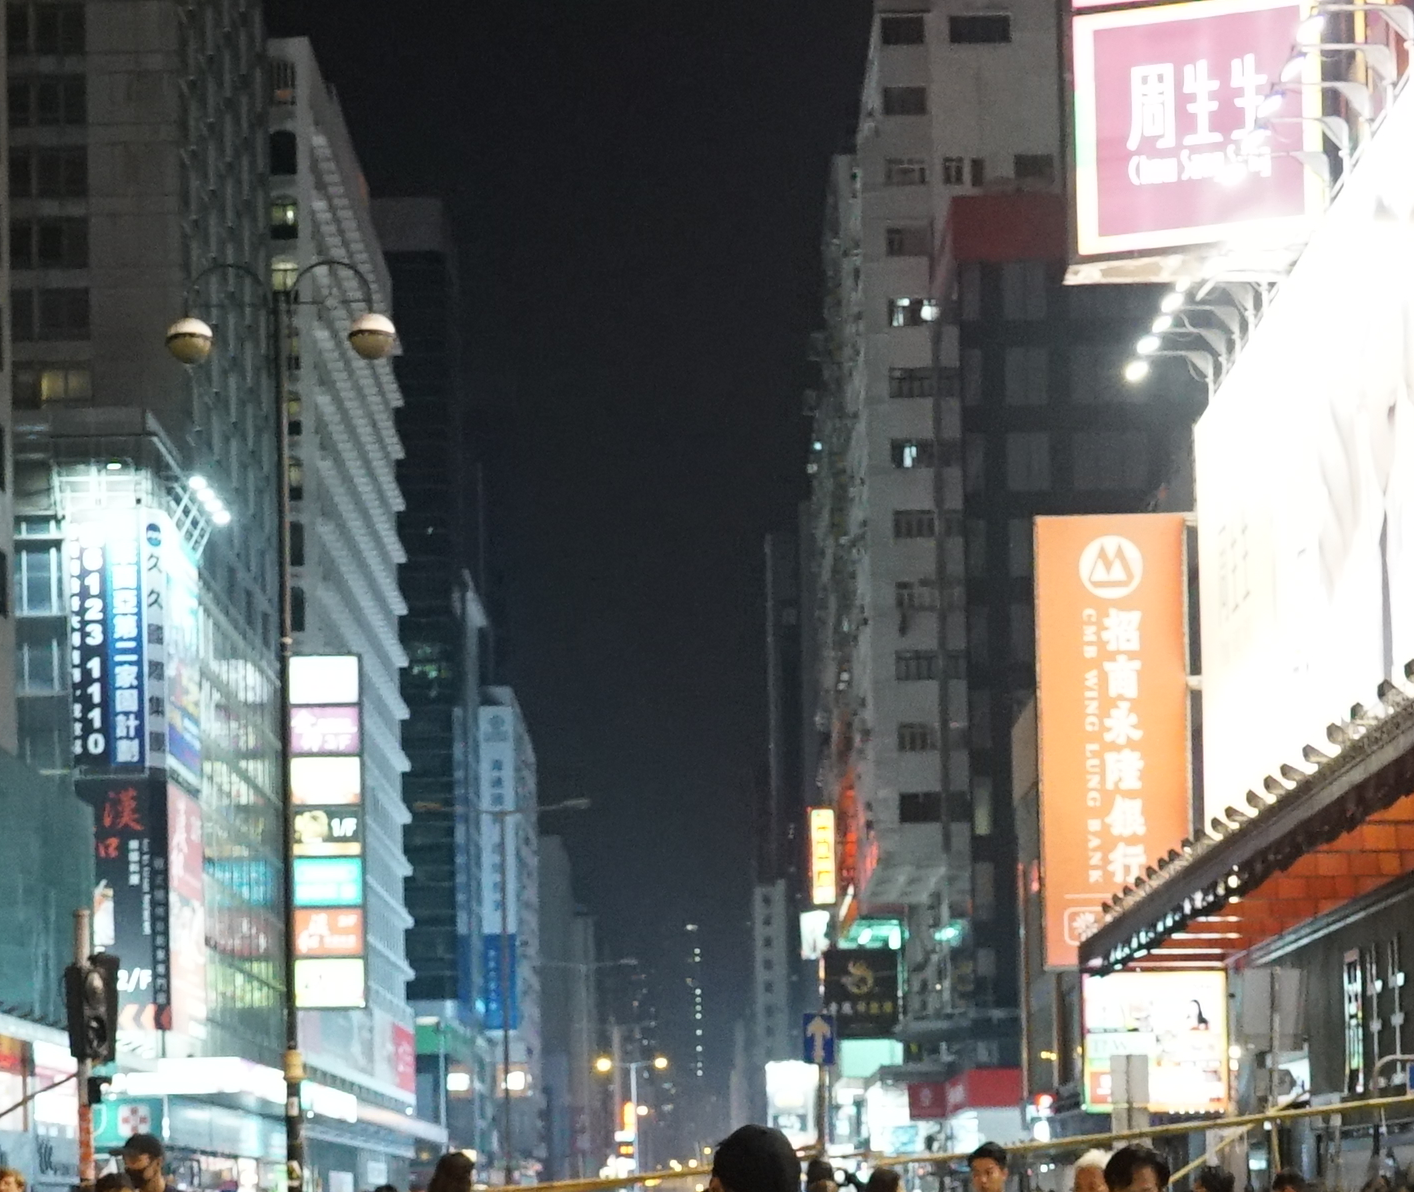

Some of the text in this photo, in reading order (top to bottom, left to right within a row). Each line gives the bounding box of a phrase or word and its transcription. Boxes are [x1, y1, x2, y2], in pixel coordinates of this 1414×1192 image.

[1126, 53, 1272, 151] 周生生
[1082, 608, 1104, 883] CMB WING LUNG BANK
[1100, 607, 1147, 884] 招商永隆銀行
[116, 967, 153, 993] 2/F
